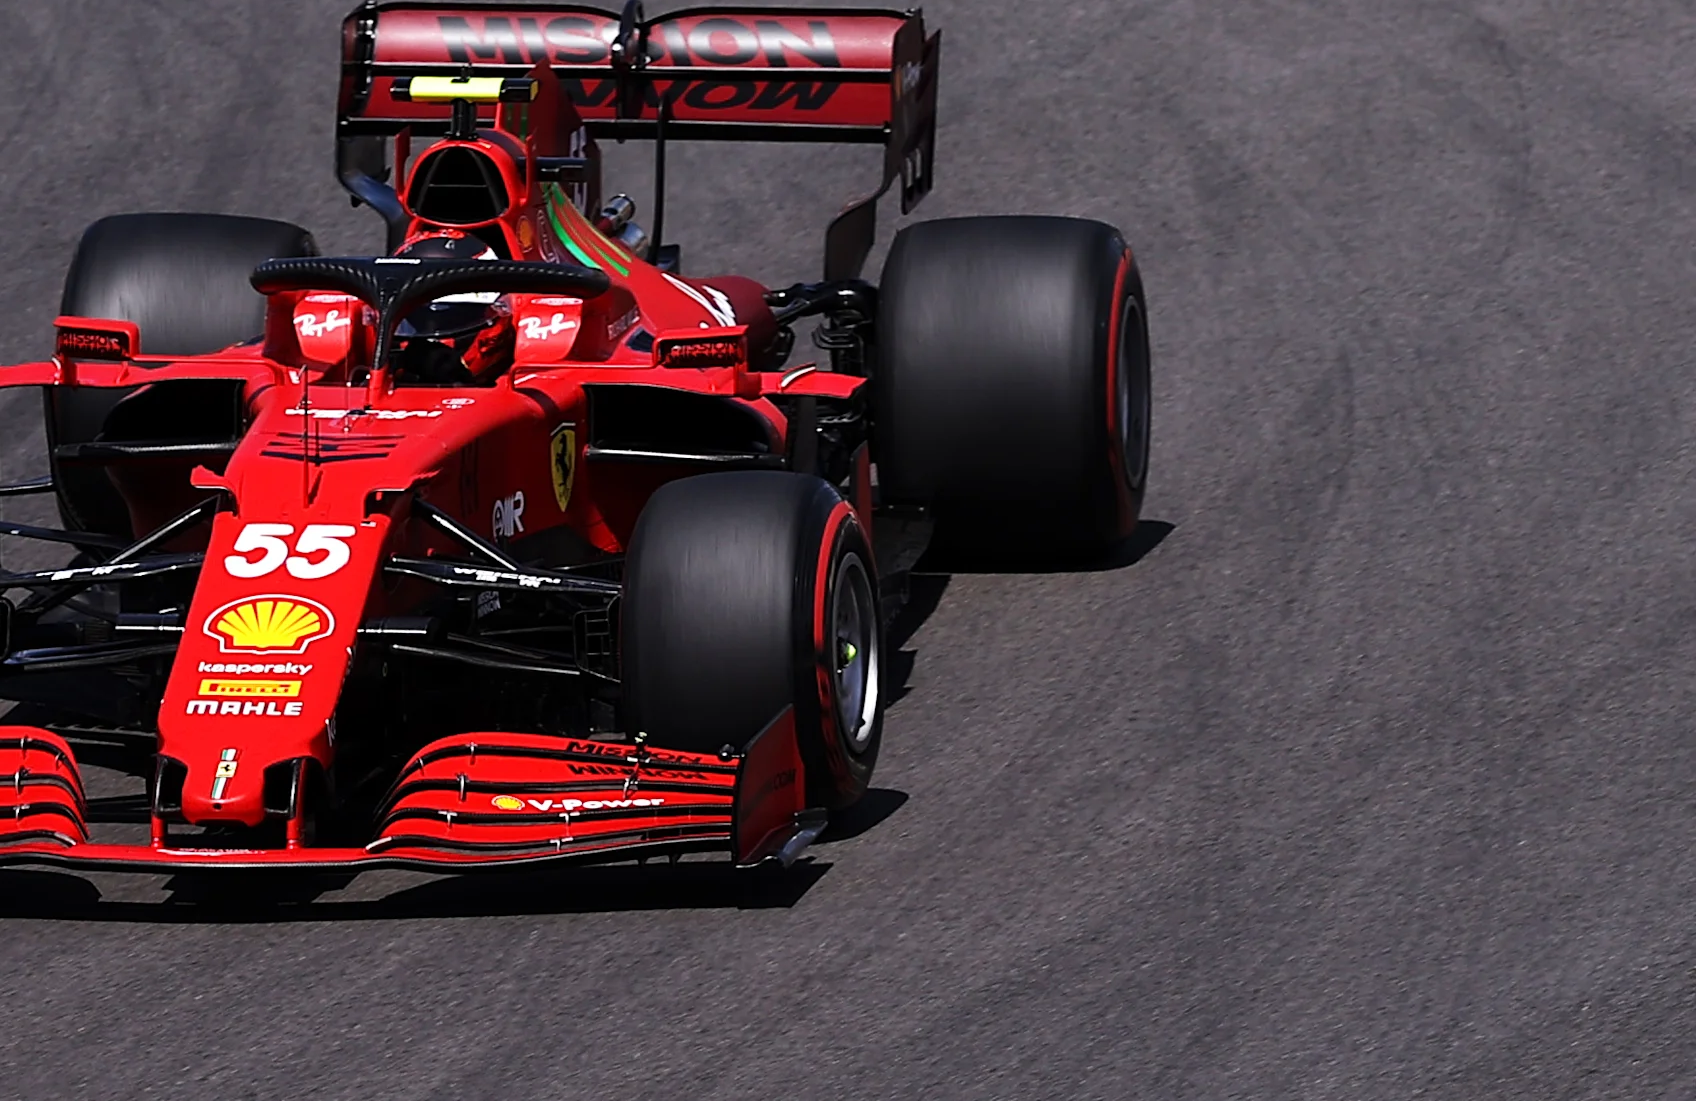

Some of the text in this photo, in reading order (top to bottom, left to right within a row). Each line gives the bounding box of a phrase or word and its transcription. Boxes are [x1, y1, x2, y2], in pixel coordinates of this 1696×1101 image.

[223, 522, 357, 580] 55
[197, 661, 314, 676] kaspersky
[185, 700, 304, 716] MAHLE
[566, 741, 704, 764] MISSON
[528, 798, 664, 812] V-Power
